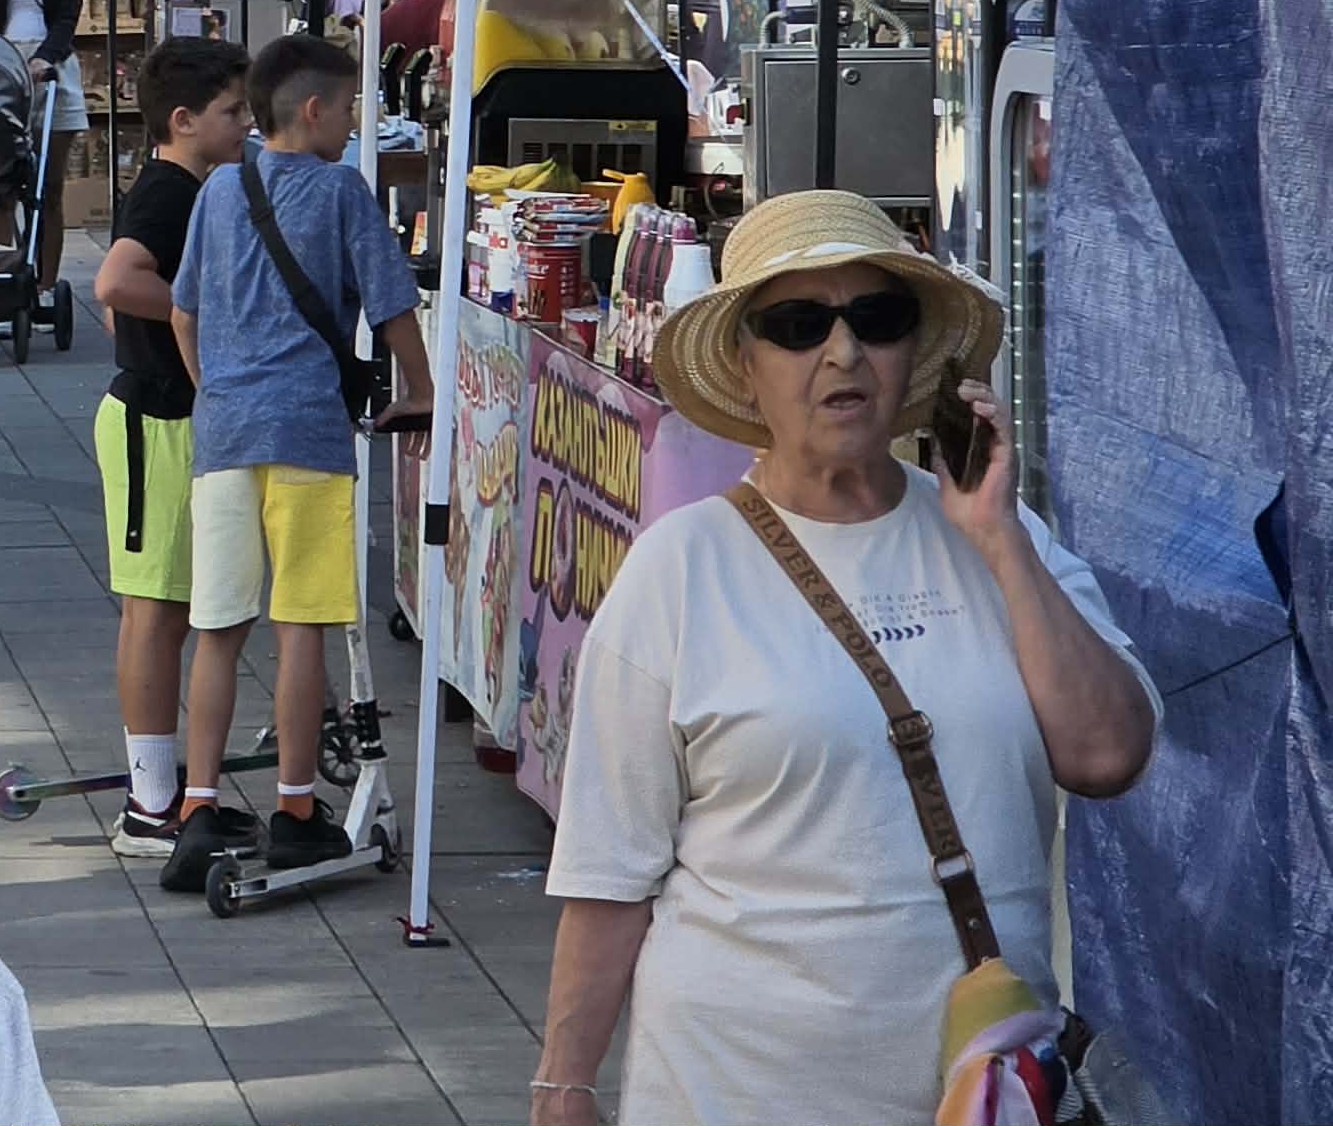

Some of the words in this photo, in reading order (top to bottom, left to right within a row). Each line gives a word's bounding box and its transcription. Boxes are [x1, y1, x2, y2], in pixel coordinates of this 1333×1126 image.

[530, 477, 633, 621] ПОНИЧ
[741, 497, 820, 589] SILVER
[813, 592, 839, 610] &
[832, 613, 893, 689] POLO
